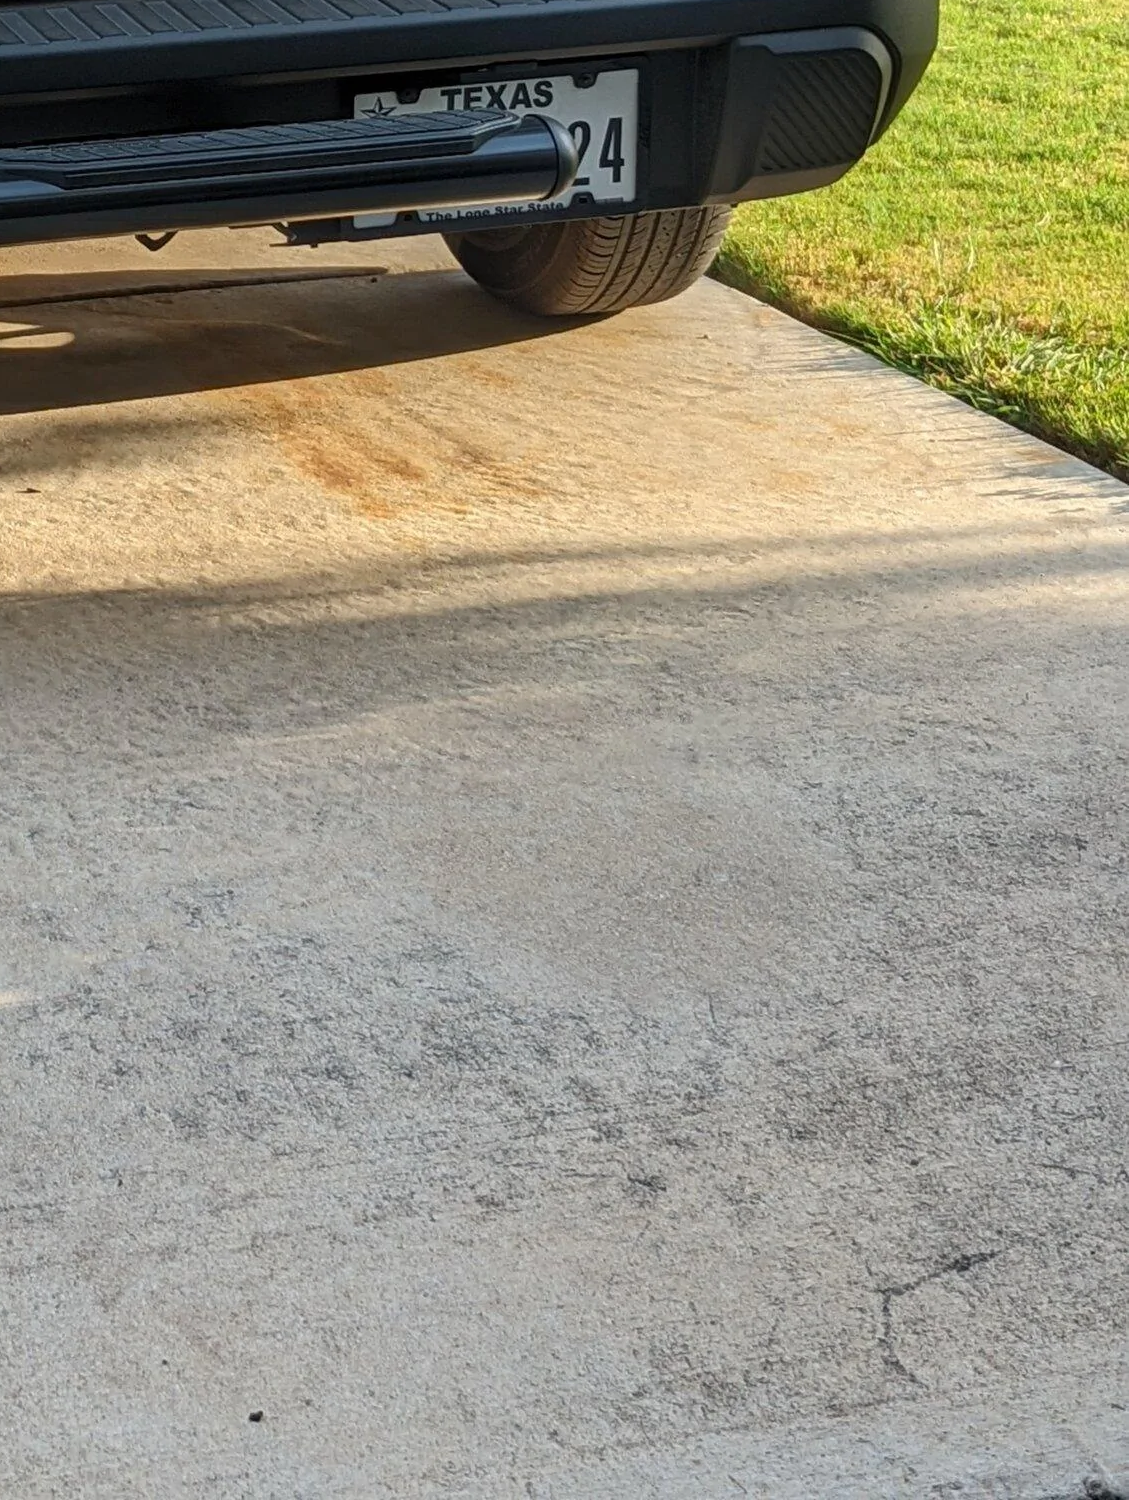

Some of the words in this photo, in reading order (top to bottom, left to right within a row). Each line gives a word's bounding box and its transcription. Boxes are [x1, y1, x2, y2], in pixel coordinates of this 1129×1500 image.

[440, 80, 554, 111] TEXAS
[426, 211, 452, 222] The
[457, 208, 491, 219] Lone
[494, 205, 524, 216] Star
[527, 201, 564, 212] State
